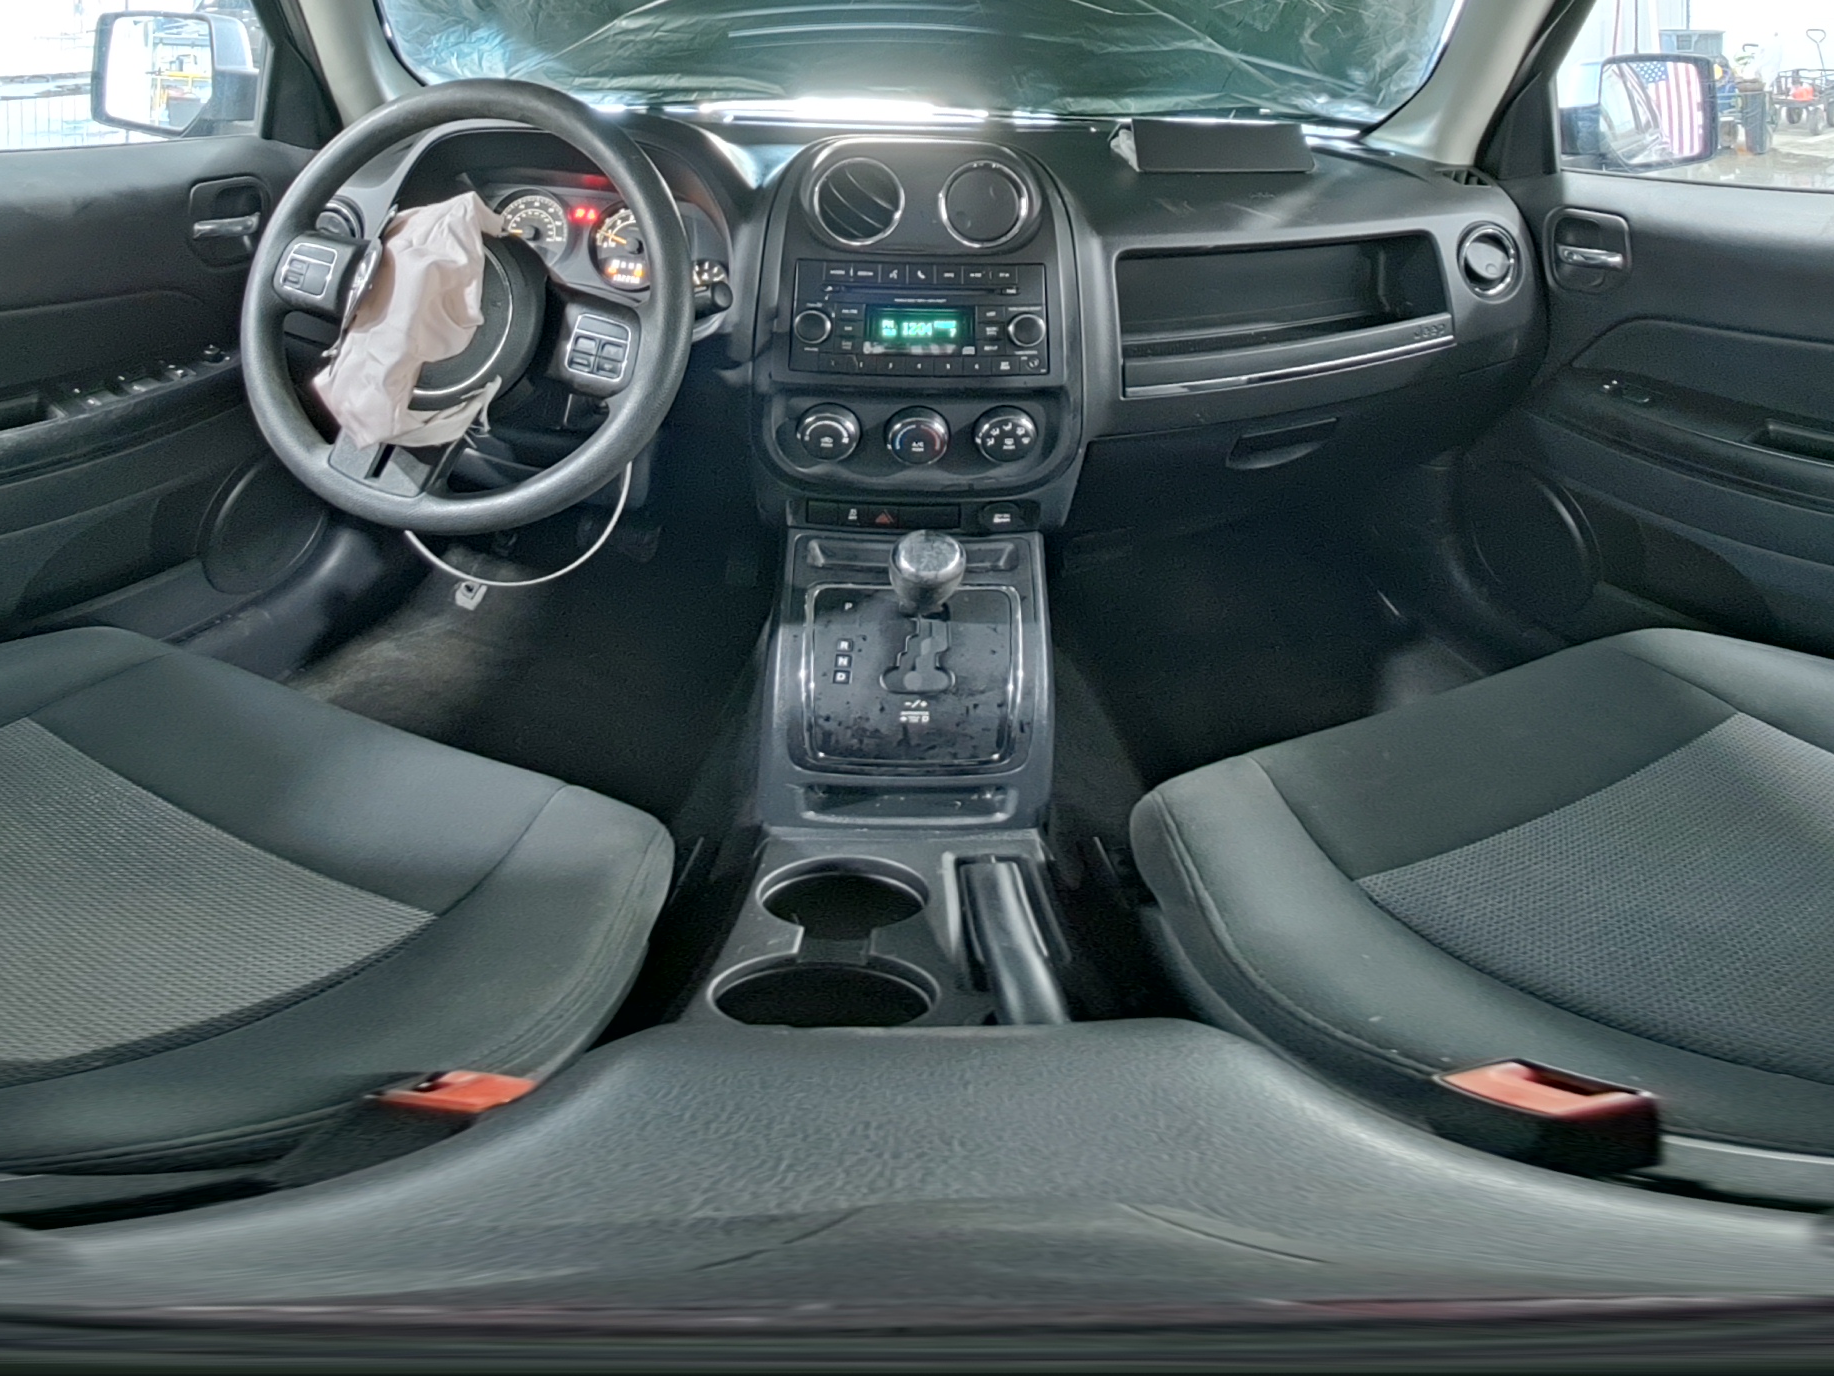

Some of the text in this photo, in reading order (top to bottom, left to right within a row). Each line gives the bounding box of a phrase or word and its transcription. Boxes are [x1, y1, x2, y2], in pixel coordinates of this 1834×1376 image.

[1414, 323, 1445, 340] Jeep
[844, 602, 853, 611] P
[840, 640, 849, 650] R
[838, 657, 848, 666] N
[835, 672, 846, 681] D
